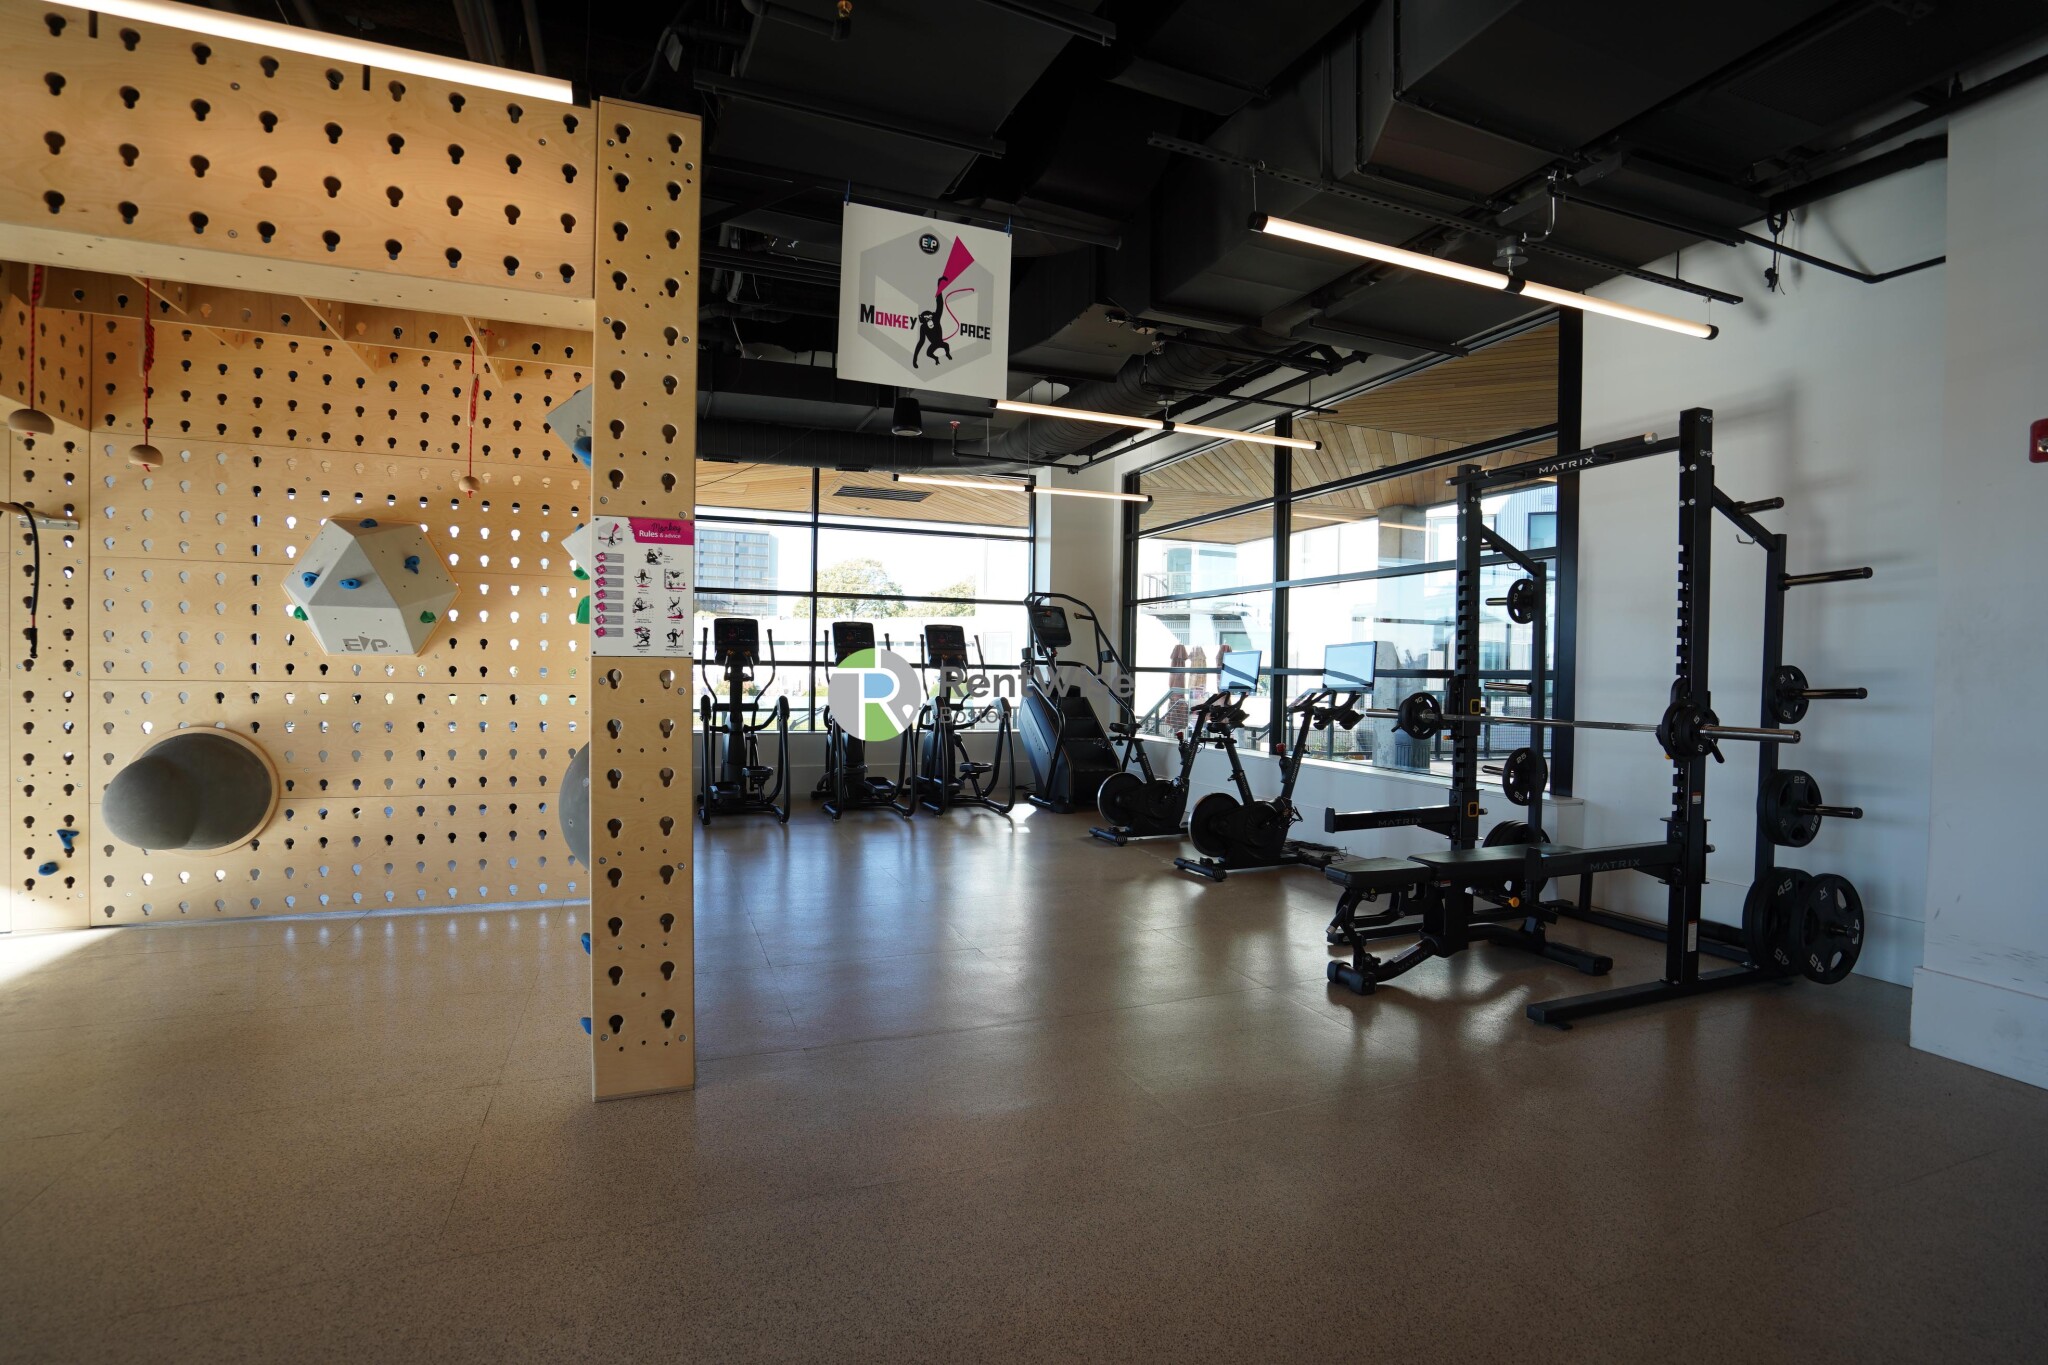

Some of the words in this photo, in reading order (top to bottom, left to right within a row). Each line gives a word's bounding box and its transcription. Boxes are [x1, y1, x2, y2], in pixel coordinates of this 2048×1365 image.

[860, 303, 918, 330] MONKEY
[1538, 457, 1594, 474] MATRIX
[639, 529, 659, 538] Rules
[1794, 775, 1806, 784] 25
[1377, 817, 1423, 827] MATRIX
[1590, 858, 1641, 871] MATRIX
[1777, 878, 1793, 897] 45
[1809, 953, 1825, 973] 45
